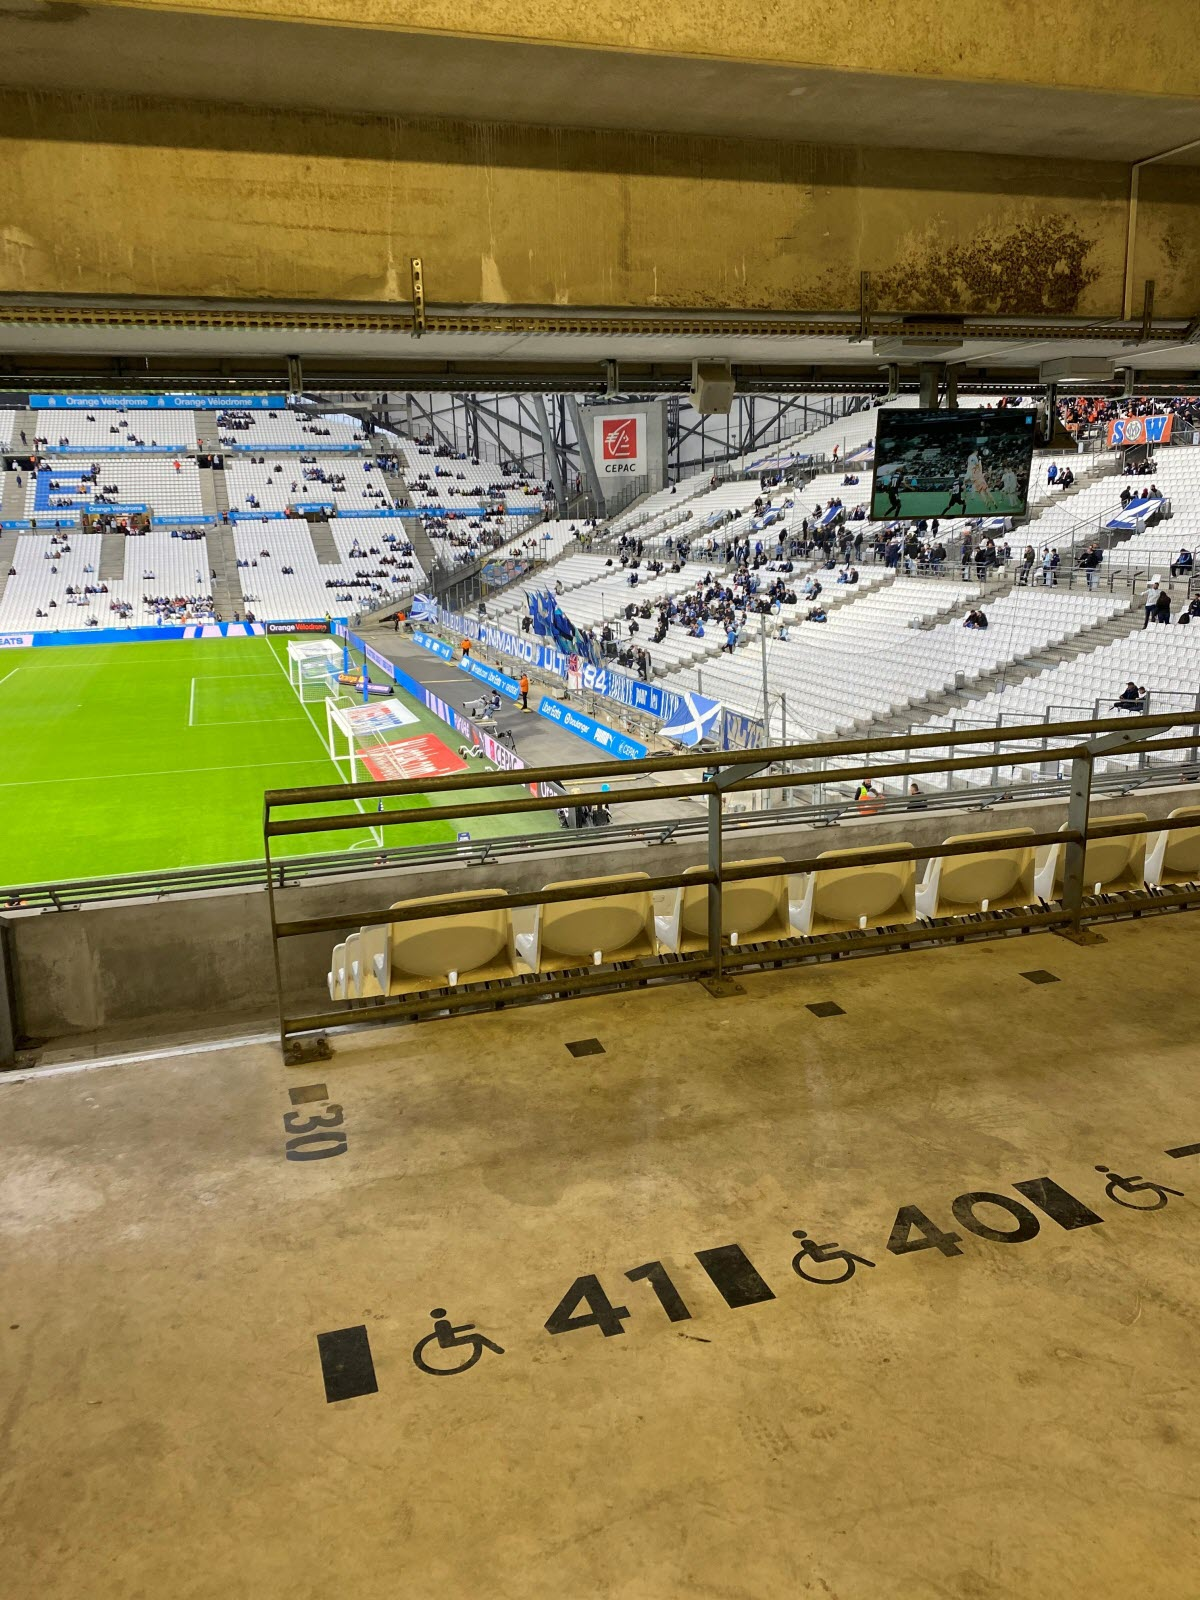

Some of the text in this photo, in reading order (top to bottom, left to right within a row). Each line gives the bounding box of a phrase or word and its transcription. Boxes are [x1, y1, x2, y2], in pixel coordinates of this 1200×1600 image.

[66, 396, 148, 406] Orange Vélodrome
[174, 397, 253, 406] Orange Vélodrome
[605, 463, 636, 473] CEPAC
[269, 624, 295, 632] Orange
[283, 1103, 348, 1161] 30
[886, 1191, 1041, 1258] 40
[543, 1260, 693, 1338] 41
